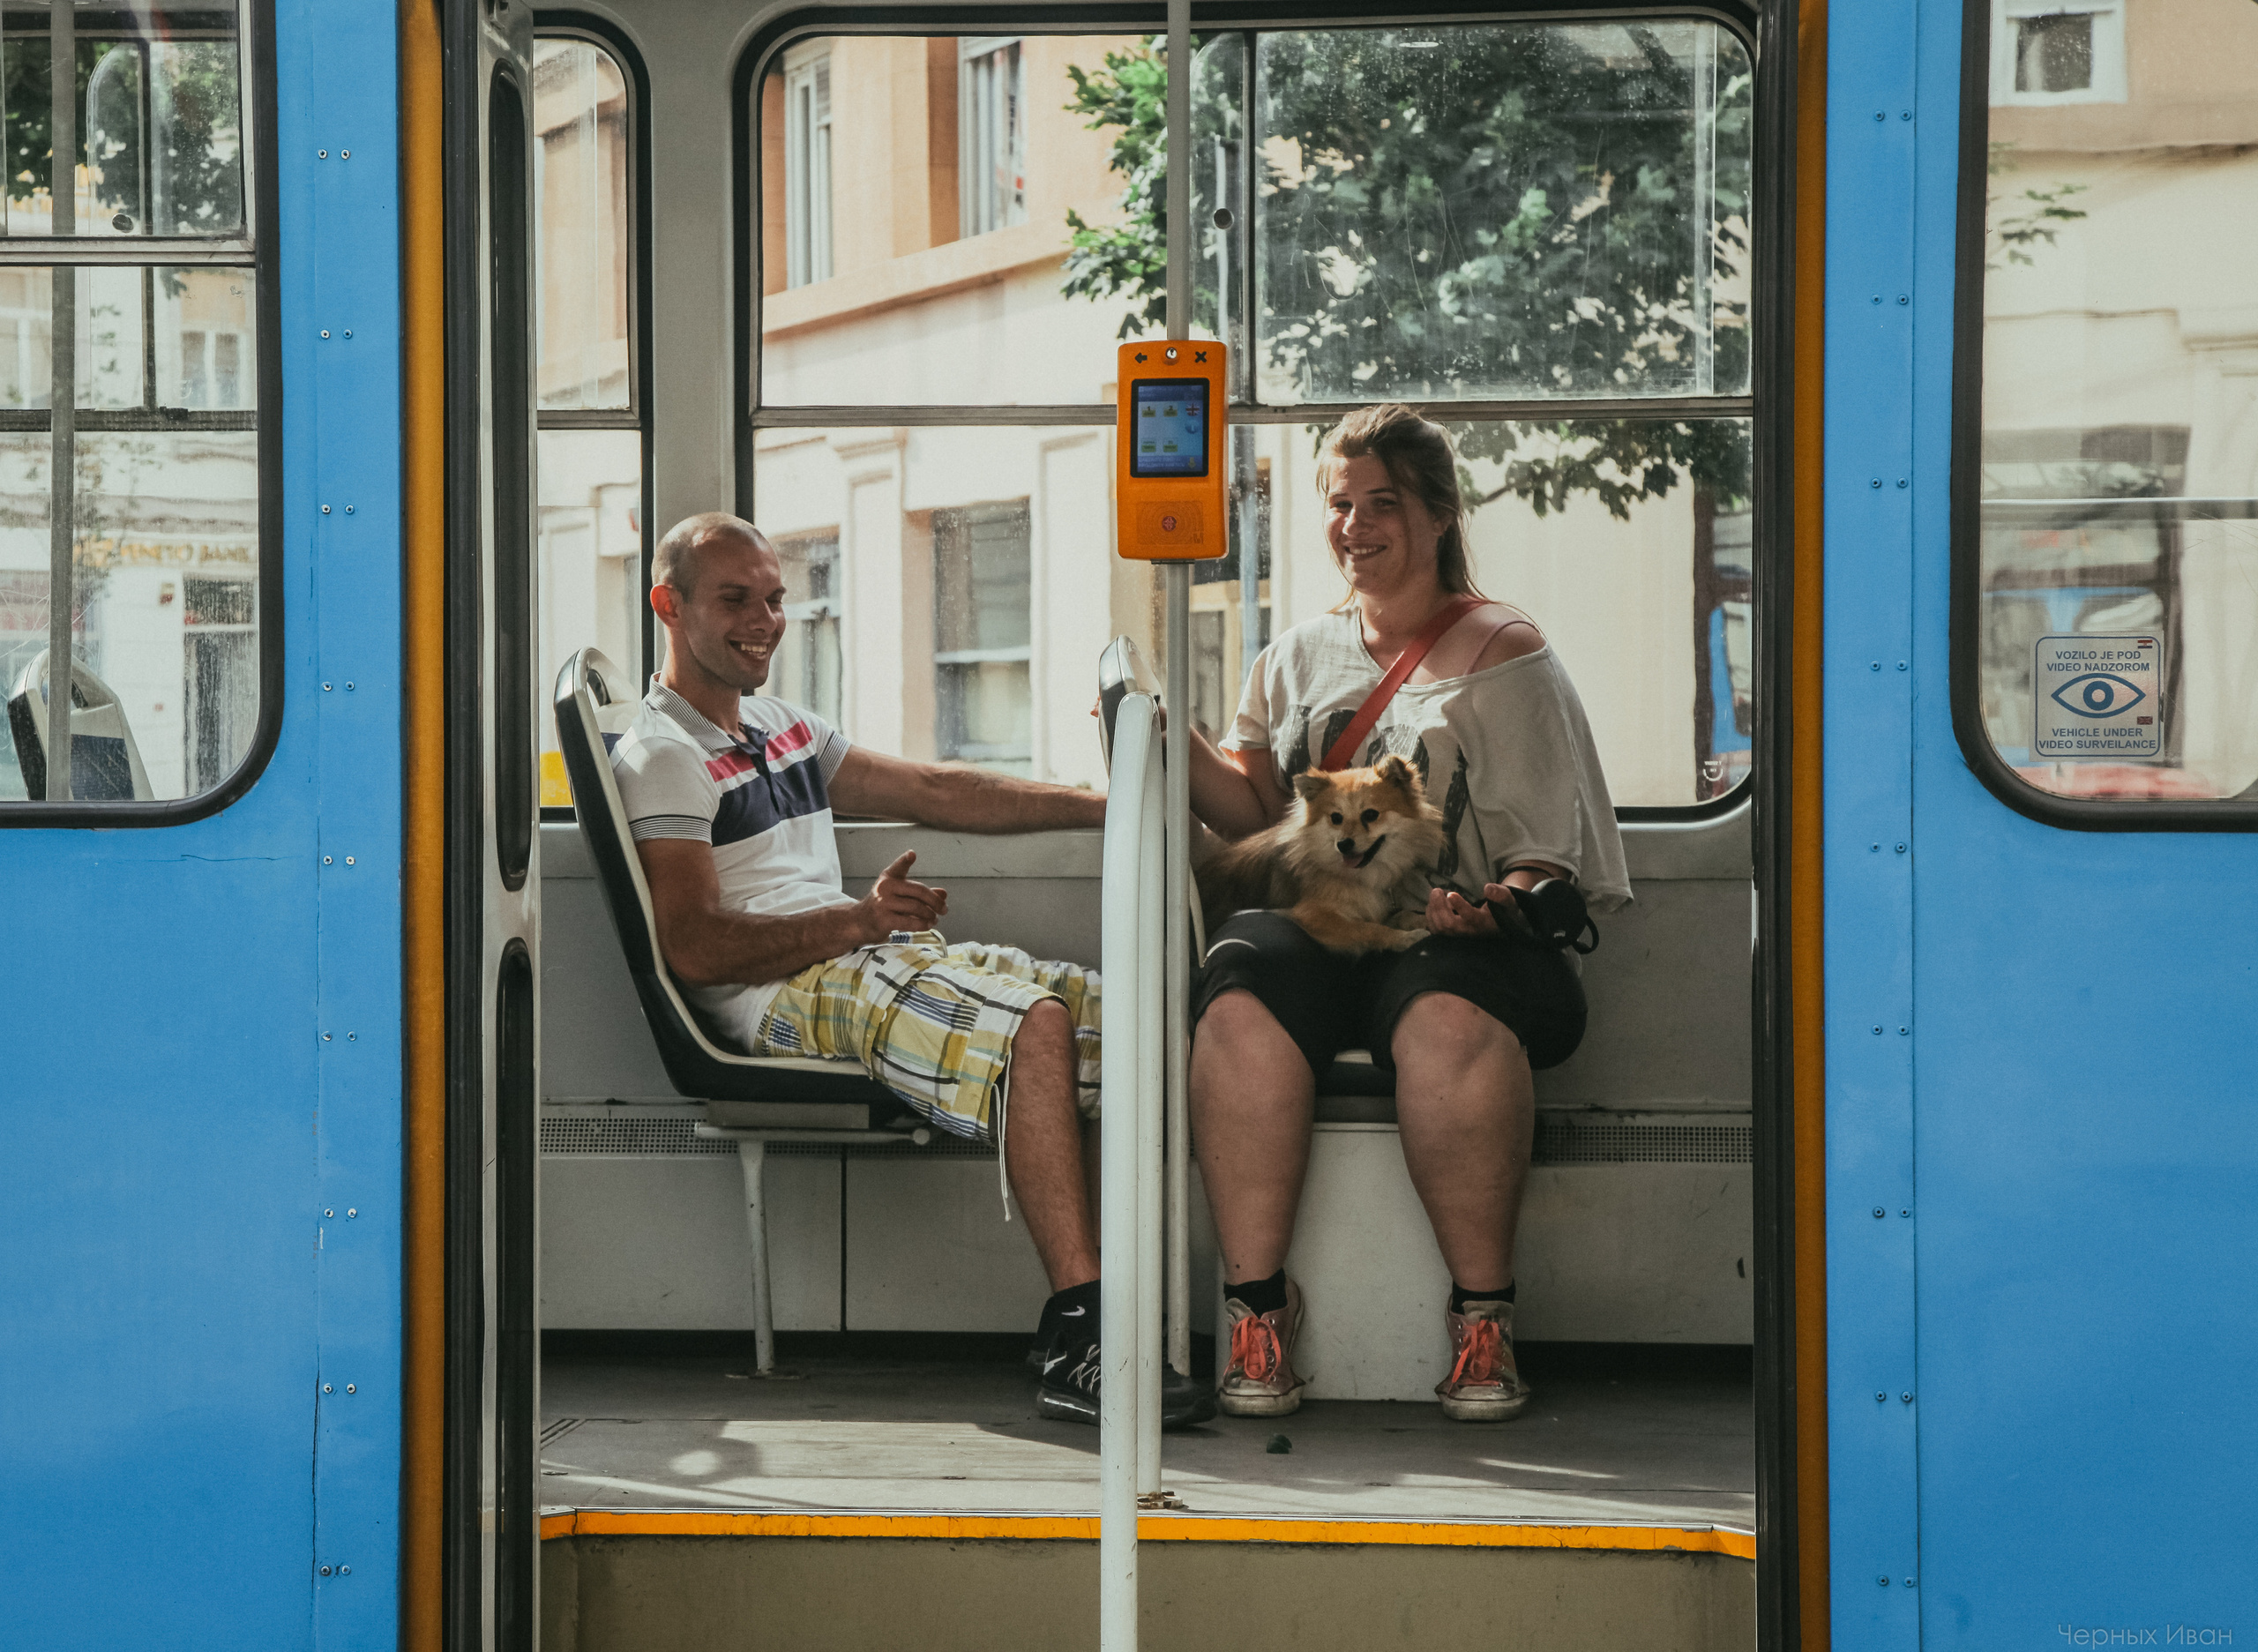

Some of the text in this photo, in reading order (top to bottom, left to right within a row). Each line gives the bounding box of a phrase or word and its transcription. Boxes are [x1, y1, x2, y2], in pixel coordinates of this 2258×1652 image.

[2055, 651, 2142, 660] VOZILO JE POD
[2046, 662, 2150, 671] VIDEO NADZOROM
[2052, 728, 2142, 736] VEHICLE UNDER
[2038, 740, 2156, 749] VIDEO SURVEILANCE
